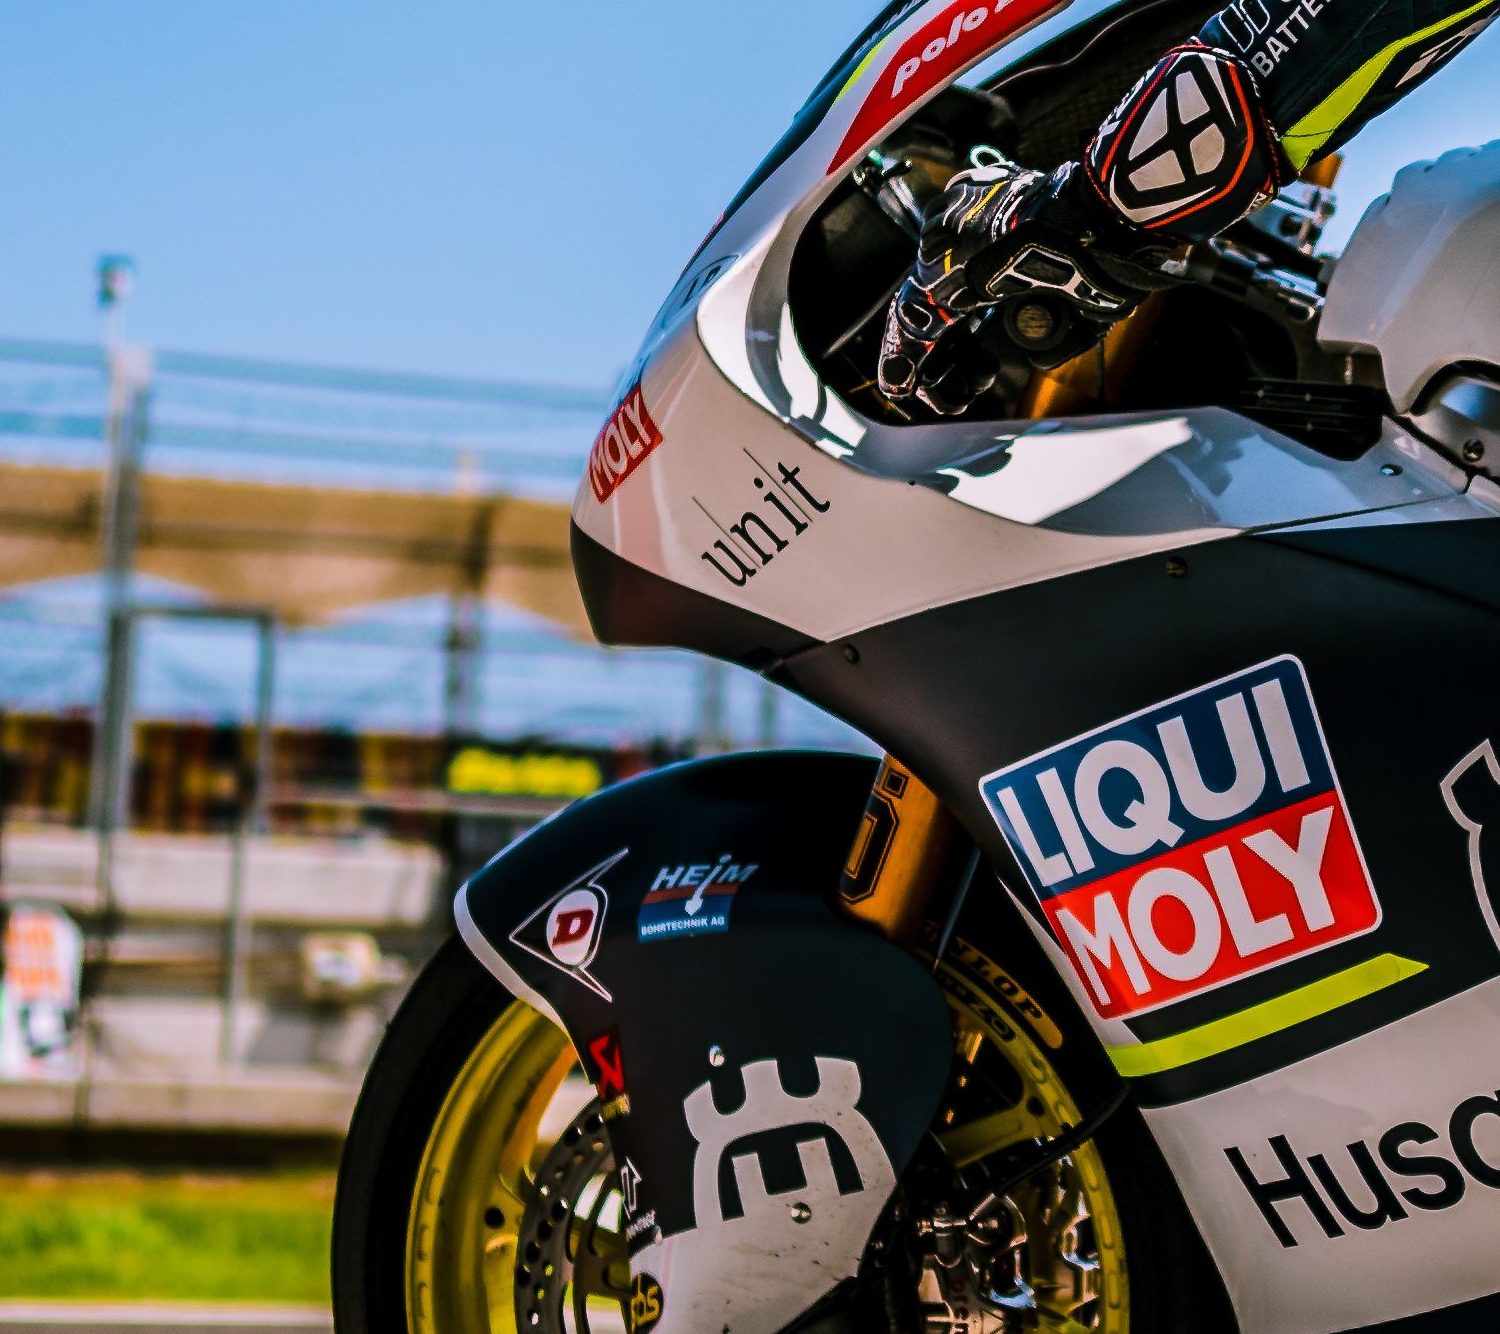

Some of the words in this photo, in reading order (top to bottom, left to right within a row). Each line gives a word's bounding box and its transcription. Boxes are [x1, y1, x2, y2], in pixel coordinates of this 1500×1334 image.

[892, 7, 988, 98] polo
[589, 391, 658, 498] MOLY
[997, 677, 1310, 886] LIQUI
[1055, 798, 1338, 1005] MOLY
